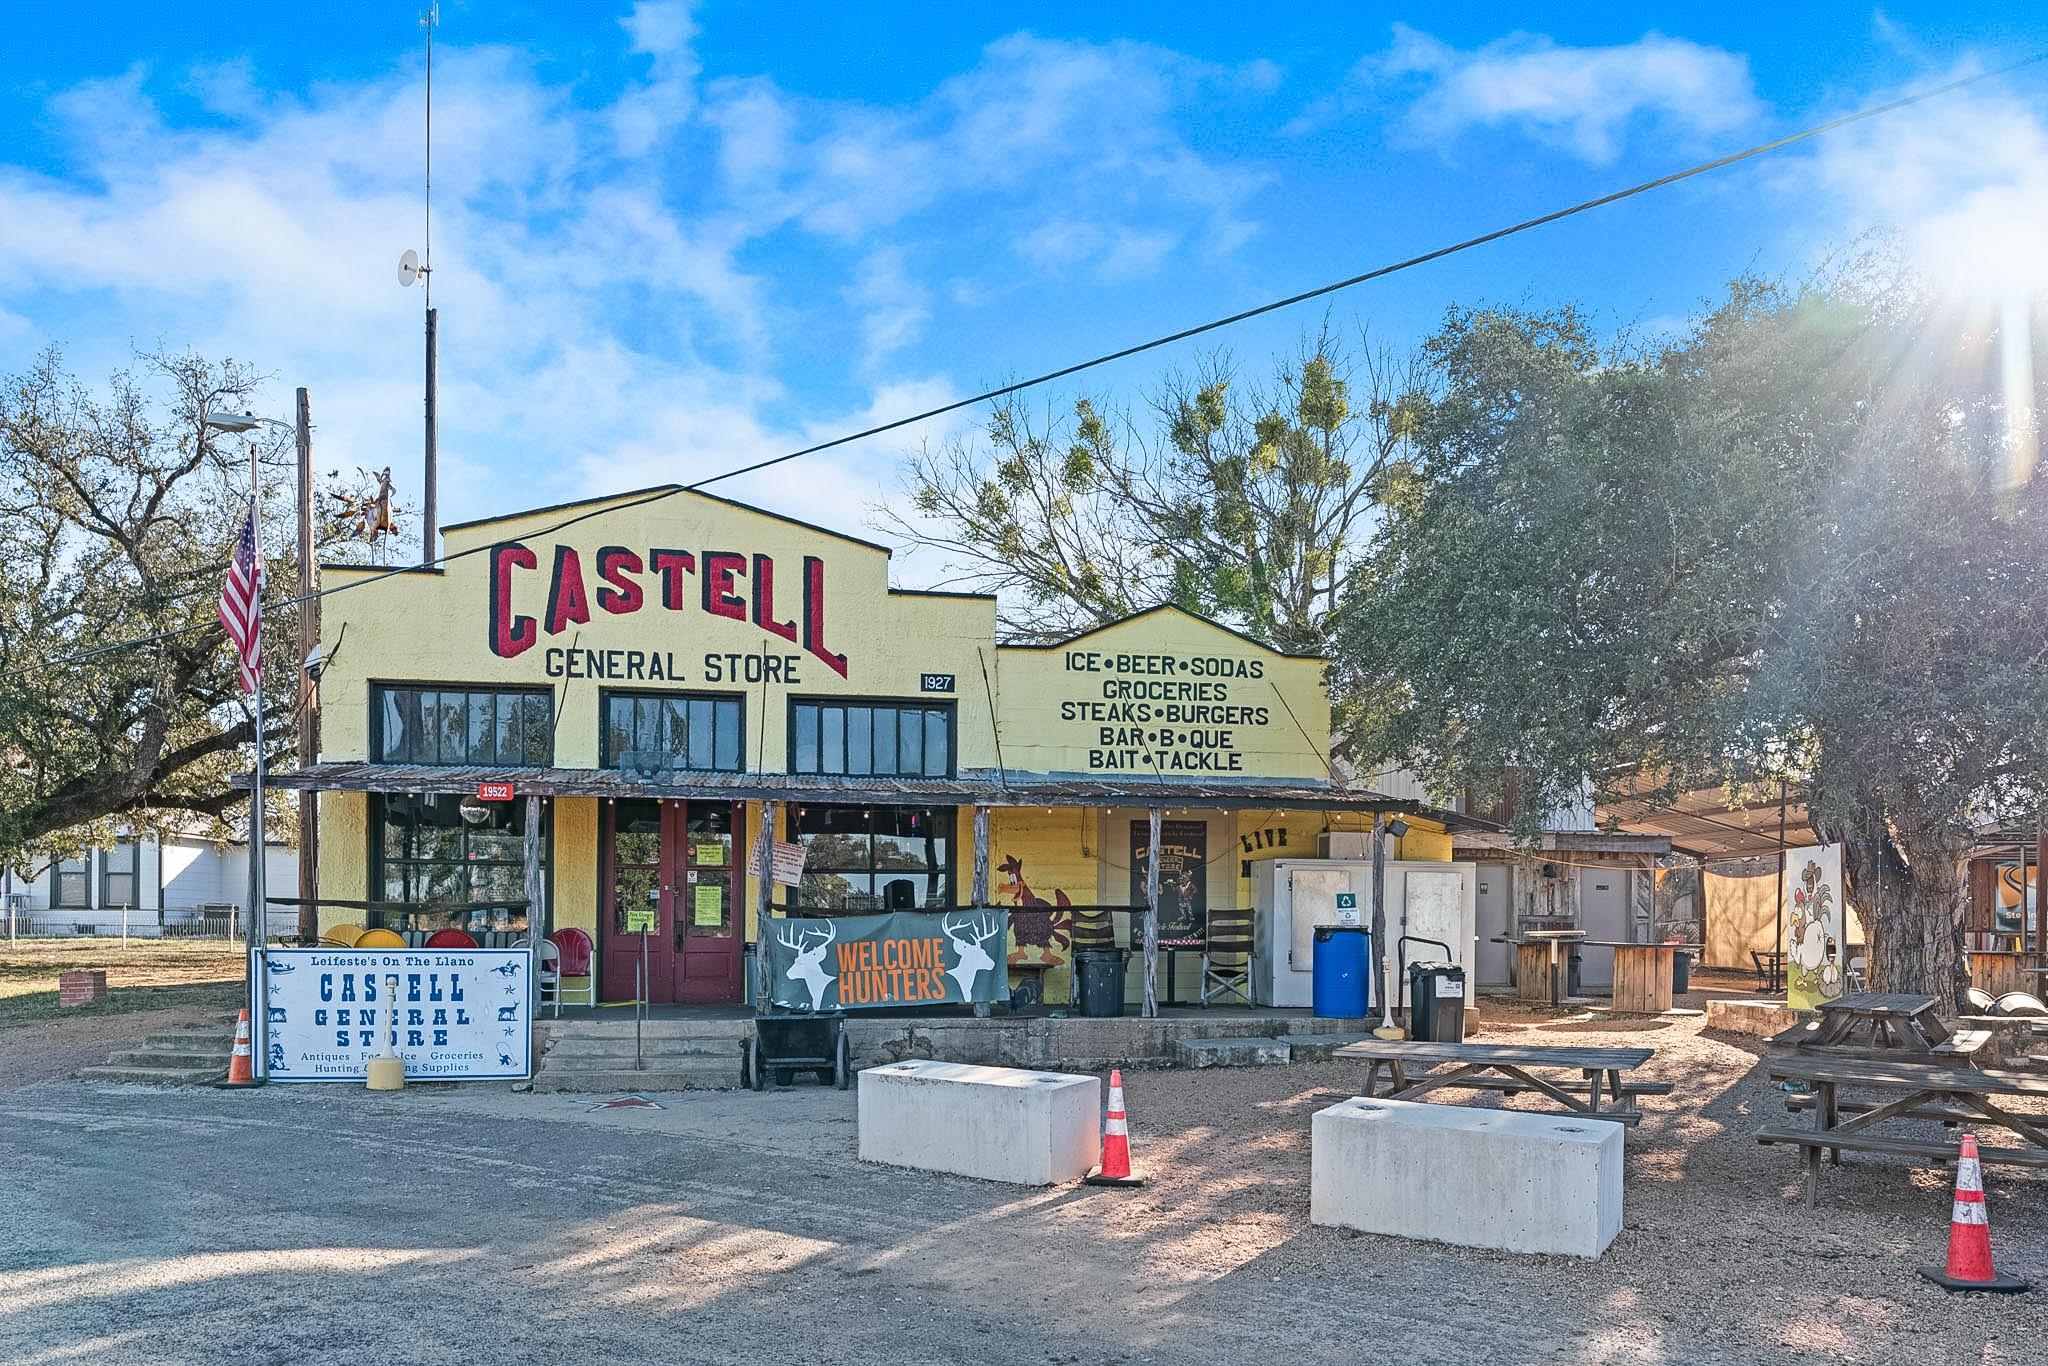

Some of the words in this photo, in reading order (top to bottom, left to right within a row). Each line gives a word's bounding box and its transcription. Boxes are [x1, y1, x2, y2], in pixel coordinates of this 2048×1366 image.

[488, 541, 848, 681] CASTELL
[545, 648, 686, 682] GENERAL
[704, 653, 801, 684] STORE
[1065, 651, 1101, 673] ICE
[1116, 654, 1177, 677] BEER
[1191, 657, 1265, 680] SODAS
[924, 675, 952, 691] 1927
[1102, 679, 1228, 702] GROCERIES
[1061, 702, 1151, 723] STEAKS
[1166, 705, 1270, 727] BURGERS
[1100, 727, 1145, 747] BAR
[1159, 729, 1175, 748] B
[1189, 729, 1234, 750] QUE
[1088, 750, 1139, 770] BAIT
[1155, 750, 1243, 772] TACKLE
[483, 786, 508, 797] 19522
[1240, 828, 1288, 853] LIVE
[311, 956, 378, 967] Leifeste's
[382, 956, 401, 967] On
[405, 956, 431, 967] The
[435, 956, 475, 967] Llano
[836, 938, 946, 972] WELCOME
[839, 967, 946, 1004] HUNTERS
[301, 1052, 351, 1063] Antiques
[430, 1051, 484, 1061] Groceries
[315, 1064, 359, 1074] Hunting
[422, 1063, 470, 1074] Supplies
